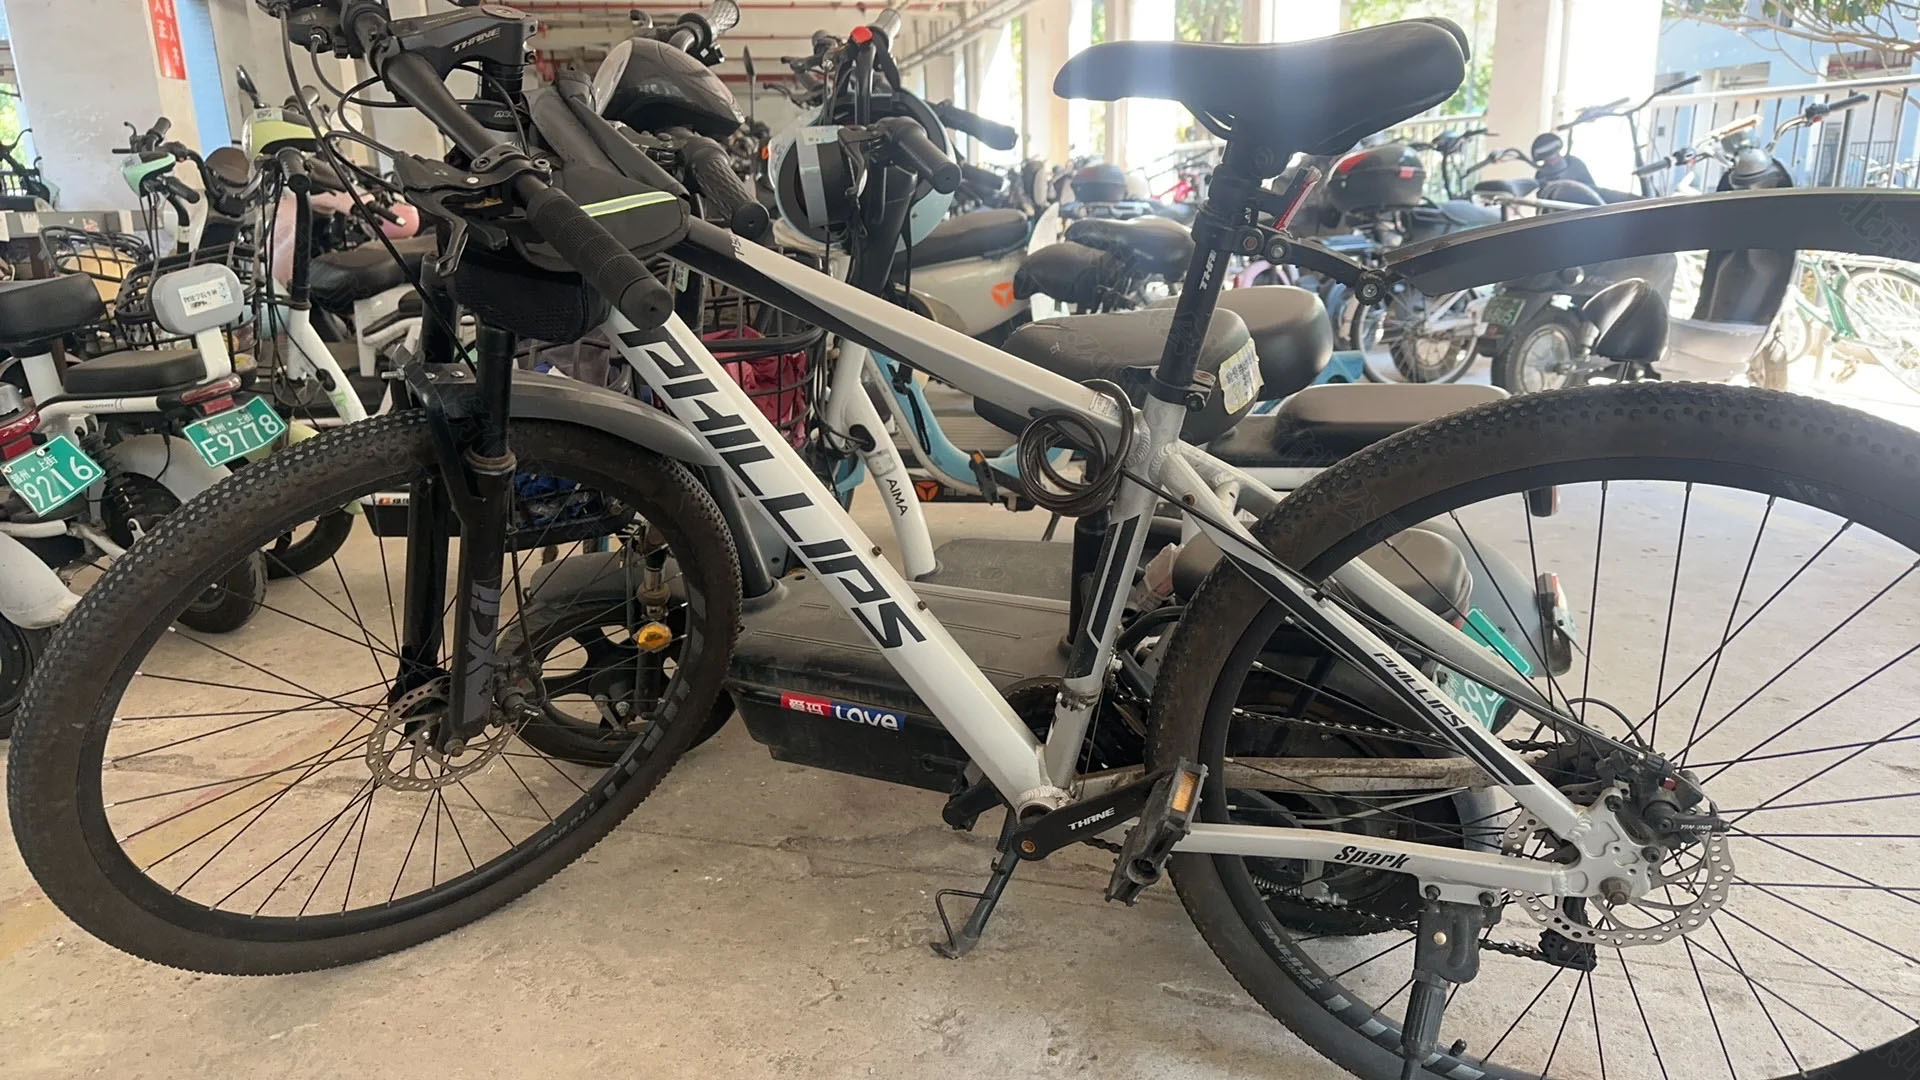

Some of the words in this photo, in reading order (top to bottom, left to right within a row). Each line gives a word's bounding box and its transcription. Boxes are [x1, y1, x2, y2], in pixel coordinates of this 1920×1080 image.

[200, 414, 279, 463] F9778
[23, 456, 94, 509] 9216
[617, 325, 927, 649] PHILLIPS
[885, 478, 908, 516] AIMA
[1372, 652, 1467, 728] PHILLIPS
[1334, 845, 1411, 869] Spark
